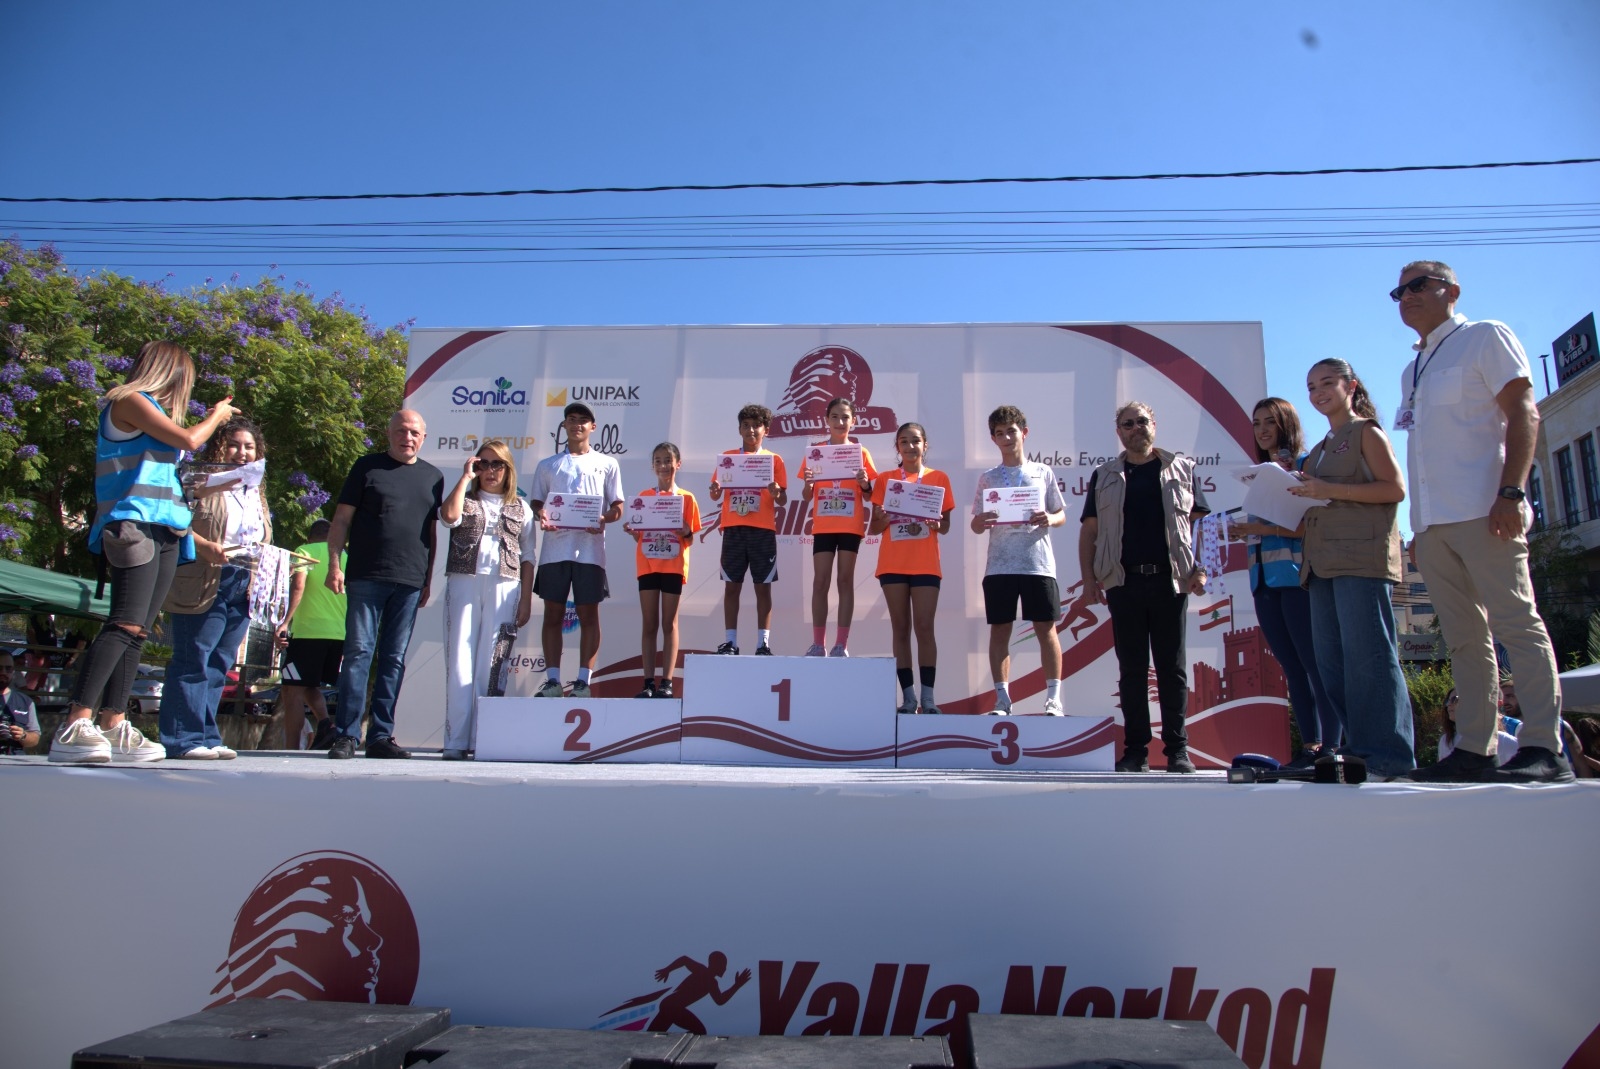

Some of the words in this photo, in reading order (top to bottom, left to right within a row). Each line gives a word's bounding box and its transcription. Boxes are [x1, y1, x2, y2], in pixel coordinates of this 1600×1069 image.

[1563, 347, 1585, 364] VIBE
[452, 385, 526, 405] Sanita
[572, 386, 640, 400] UNIPAK
[1027, 451, 1072, 466] Make
[1078, 452, 1118, 466] Ever
[771, 679, 791, 721] 1
[563, 709, 591, 751] 2
[991, 721, 1020, 765] 3
